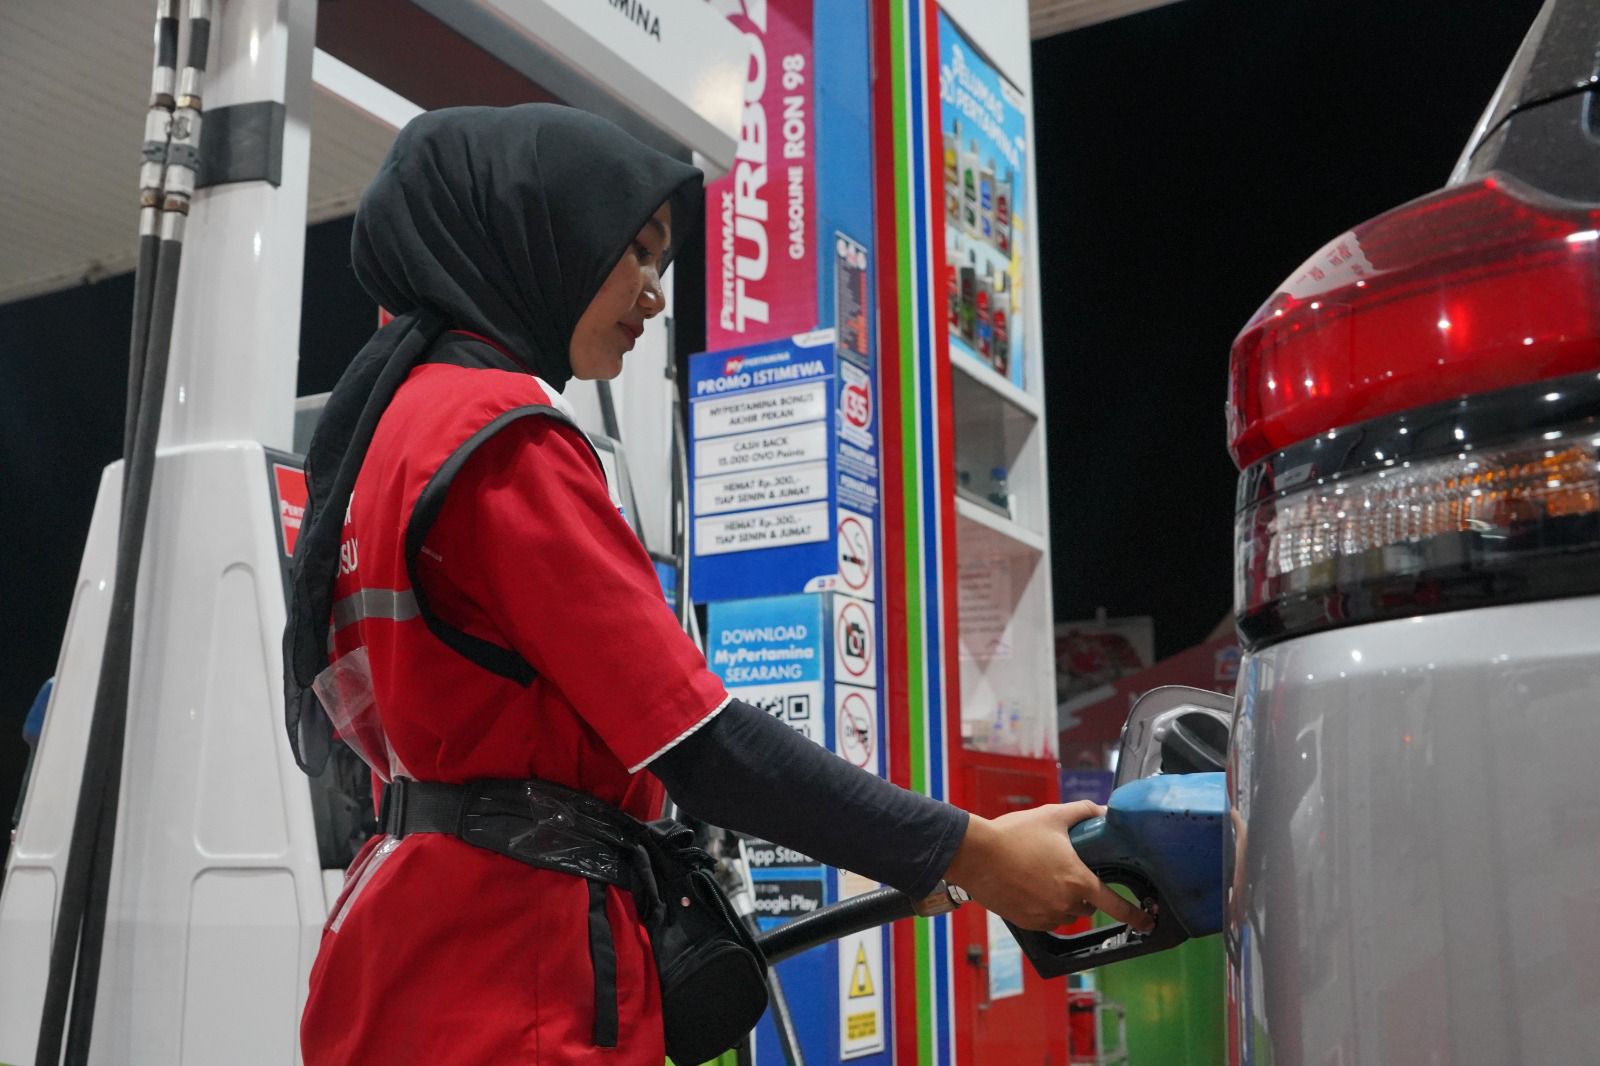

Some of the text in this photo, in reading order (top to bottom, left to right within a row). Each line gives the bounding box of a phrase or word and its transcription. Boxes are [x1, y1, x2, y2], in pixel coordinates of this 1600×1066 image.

[608, 0, 660, 42] MINA
[782, 53, 805, 90] 98
[783, 95, 805, 158] RON
[735, 32, 769, 333] TURBO
[720, 190, 735, 331] PERTAMAX
[697, 373, 751, 395] PROMO
[753, 360, 825, 385] ISTIMEWA
[761, 409, 794, 420] PEKAN
[733, 437, 789, 452] CASH BACK
[752, 450, 774, 461] OVO
[715, 486, 811, 505] TIAP SENIN & JUMAT
[723, 481, 755, 491] HEMAT
[716, 525, 812, 545] TIAP SENIN & JUMAT
[724, 519, 756, 531] HEMAT
[722, 624, 808, 646] DOWNLOAD
[714, 643, 815, 667] MyPertamina
[726, 663, 803, 683] SEKARANG
[747, 846, 775, 867] App
[753, 894, 818, 915] oogle Play
